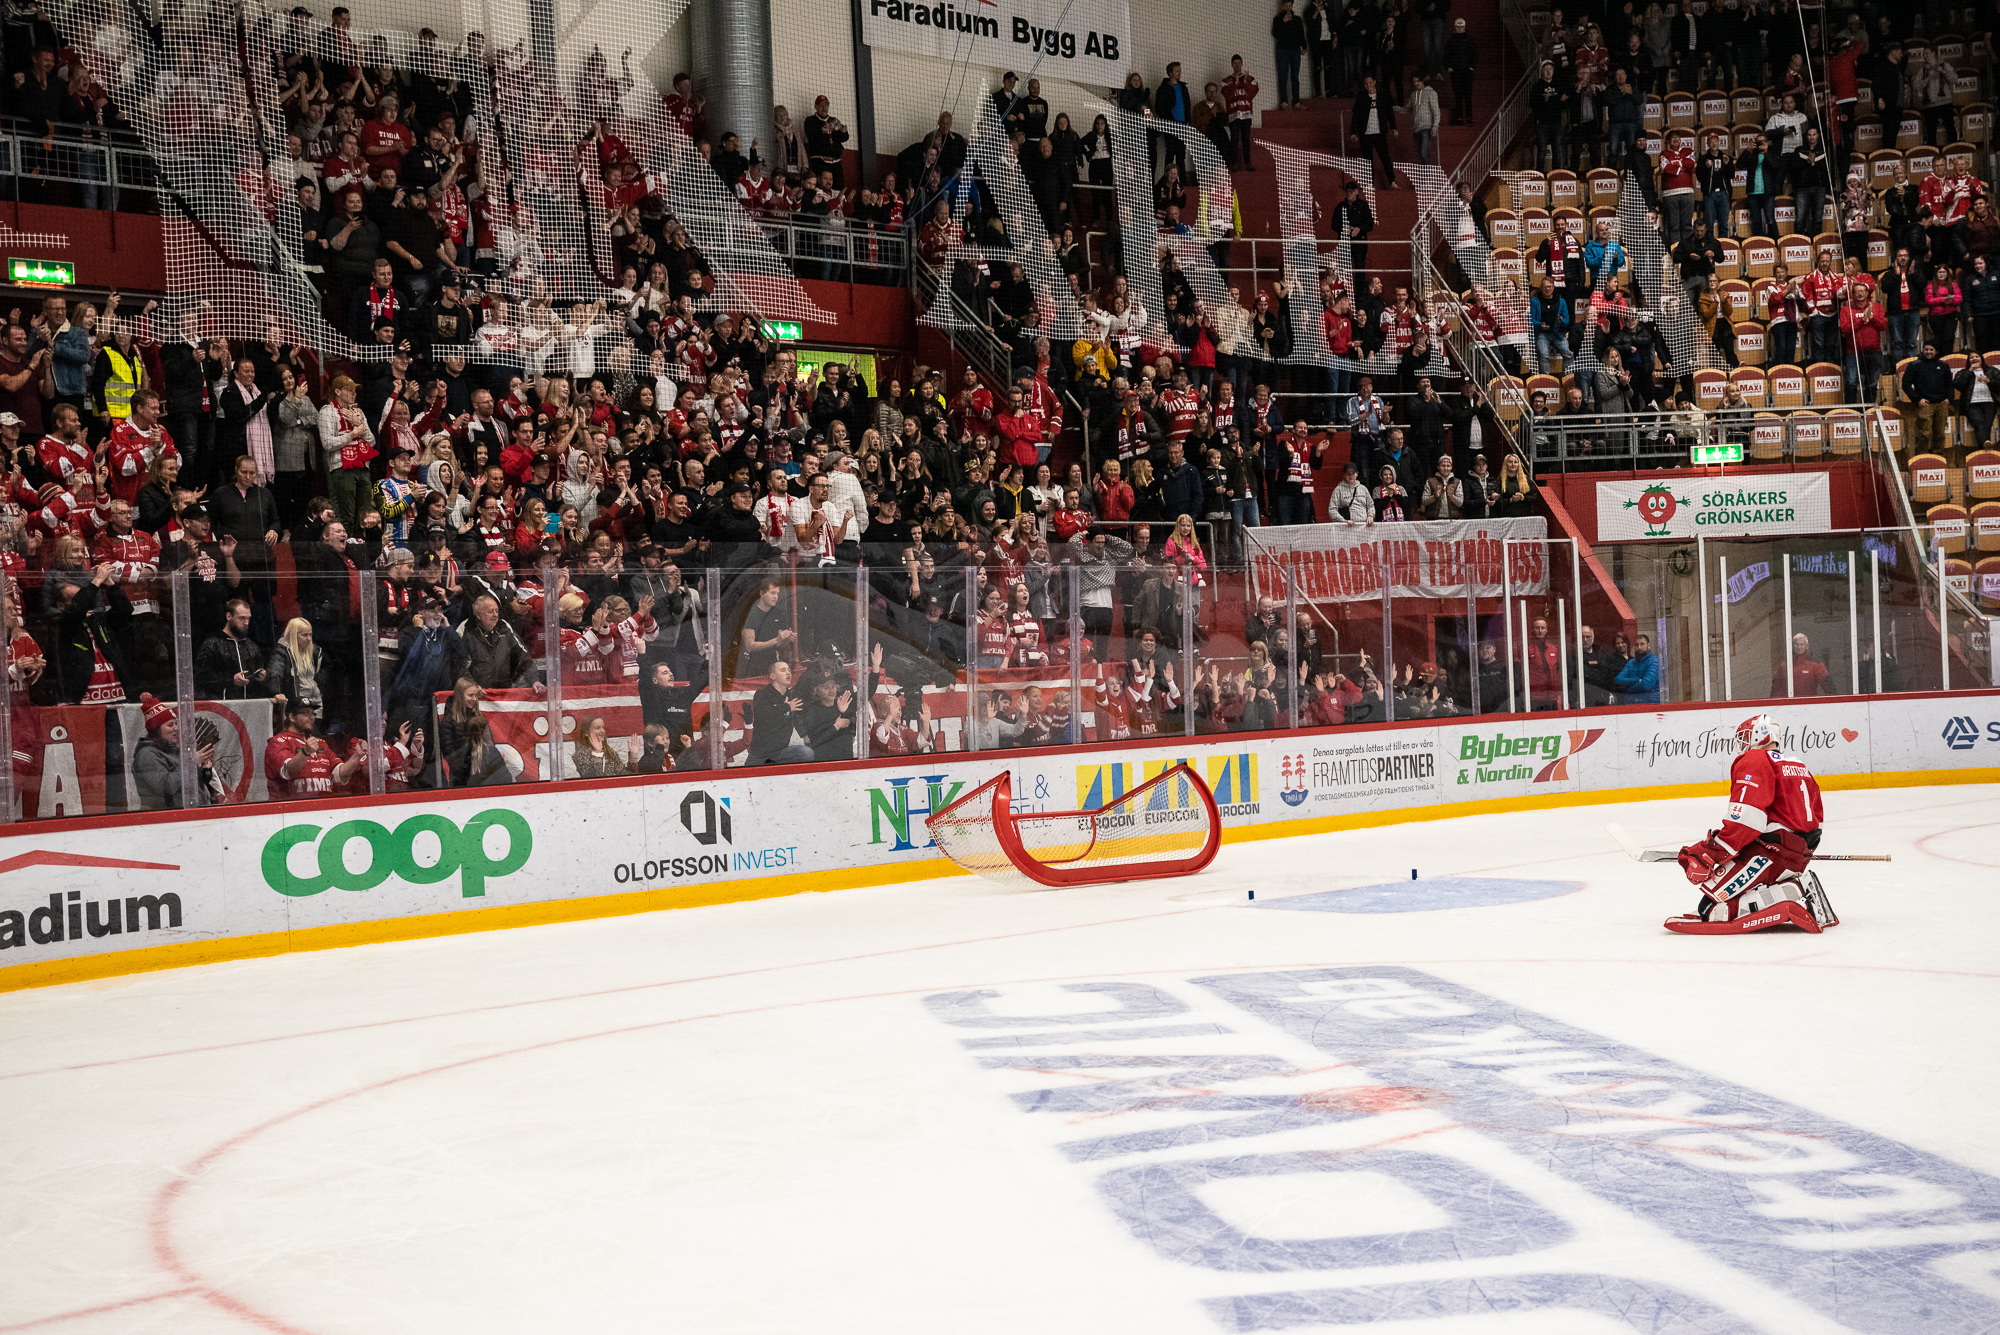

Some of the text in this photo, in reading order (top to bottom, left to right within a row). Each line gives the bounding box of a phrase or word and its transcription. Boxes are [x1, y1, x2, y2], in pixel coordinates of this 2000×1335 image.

[870, 0, 1120, 61] Faradium Bygg AB
[1940, 47, 1960, 56] MAXI
[1955, 81, 1976, 89] MAXI
[1672, 105, 1692, 113] MAXI
[1706, 103, 1725, 112] MAXI
[1739, 101, 1758, 109] MAXI
[1860, 127, 1882, 136] MAXI
[1525, 184, 1544, 192] MAXI
[1556, 184, 1575, 192] MAXI
[1596, 182, 1616, 190] MAXI
[1496, 223, 1516, 231] MAXI
[1530, 221, 1549, 229] MAXI
[1752, 253, 1772, 263] MAXI
[1787, 250, 1809, 259] MAXI
[1740, 338, 1762, 347] MAXI
[1740, 383, 1762, 392] MAXI
[1778, 381, 1800, 390] MAXI
[1817, 379, 1839, 388] MAXI
[1703, 385, 1724, 396] MAXI
[1757, 430, 1779, 439] MAXI
[1797, 428, 1819, 437] MAXI
[1836, 425, 1859, 435] MAXI
[1919, 473, 1943, 482] MAXI
[1702, 489, 1788, 508] SÖRÅKERS
[1695, 508, 1795, 525] GRÖNSAKER
[1507, 537, 1543, 584] OSS
[1313, 747, 1335, 757] Denna
[1335, 745, 1365, 757] sargplats
[1366, 743, 1384, 753] lottas
[1384, 743, 1393, 751] ut
[1420, 739, 1434, 748] våra
[1459, 733, 1562, 766] Byberg
[1649, 732, 1691, 767] from
[1801, 725, 1836, 754] love
[1313, 753, 1435, 788] FRAMTIDSPARTNER
[1456, 764, 1534, 785] & Nordin
[1384, 785, 1415, 795] FRAMTIDENS
[1415, 782, 1430, 792] TIMRÅ
[1739, 786, 1748, 803] 1
[1799, 779, 1814, 822] 1
[1145, 808, 1200, 825] EUROCON
[261, 807, 533, 898] coop
[613, 846, 799, 884] OLOFSSON INVEST
[1742, 913, 1781, 929] BAUER
